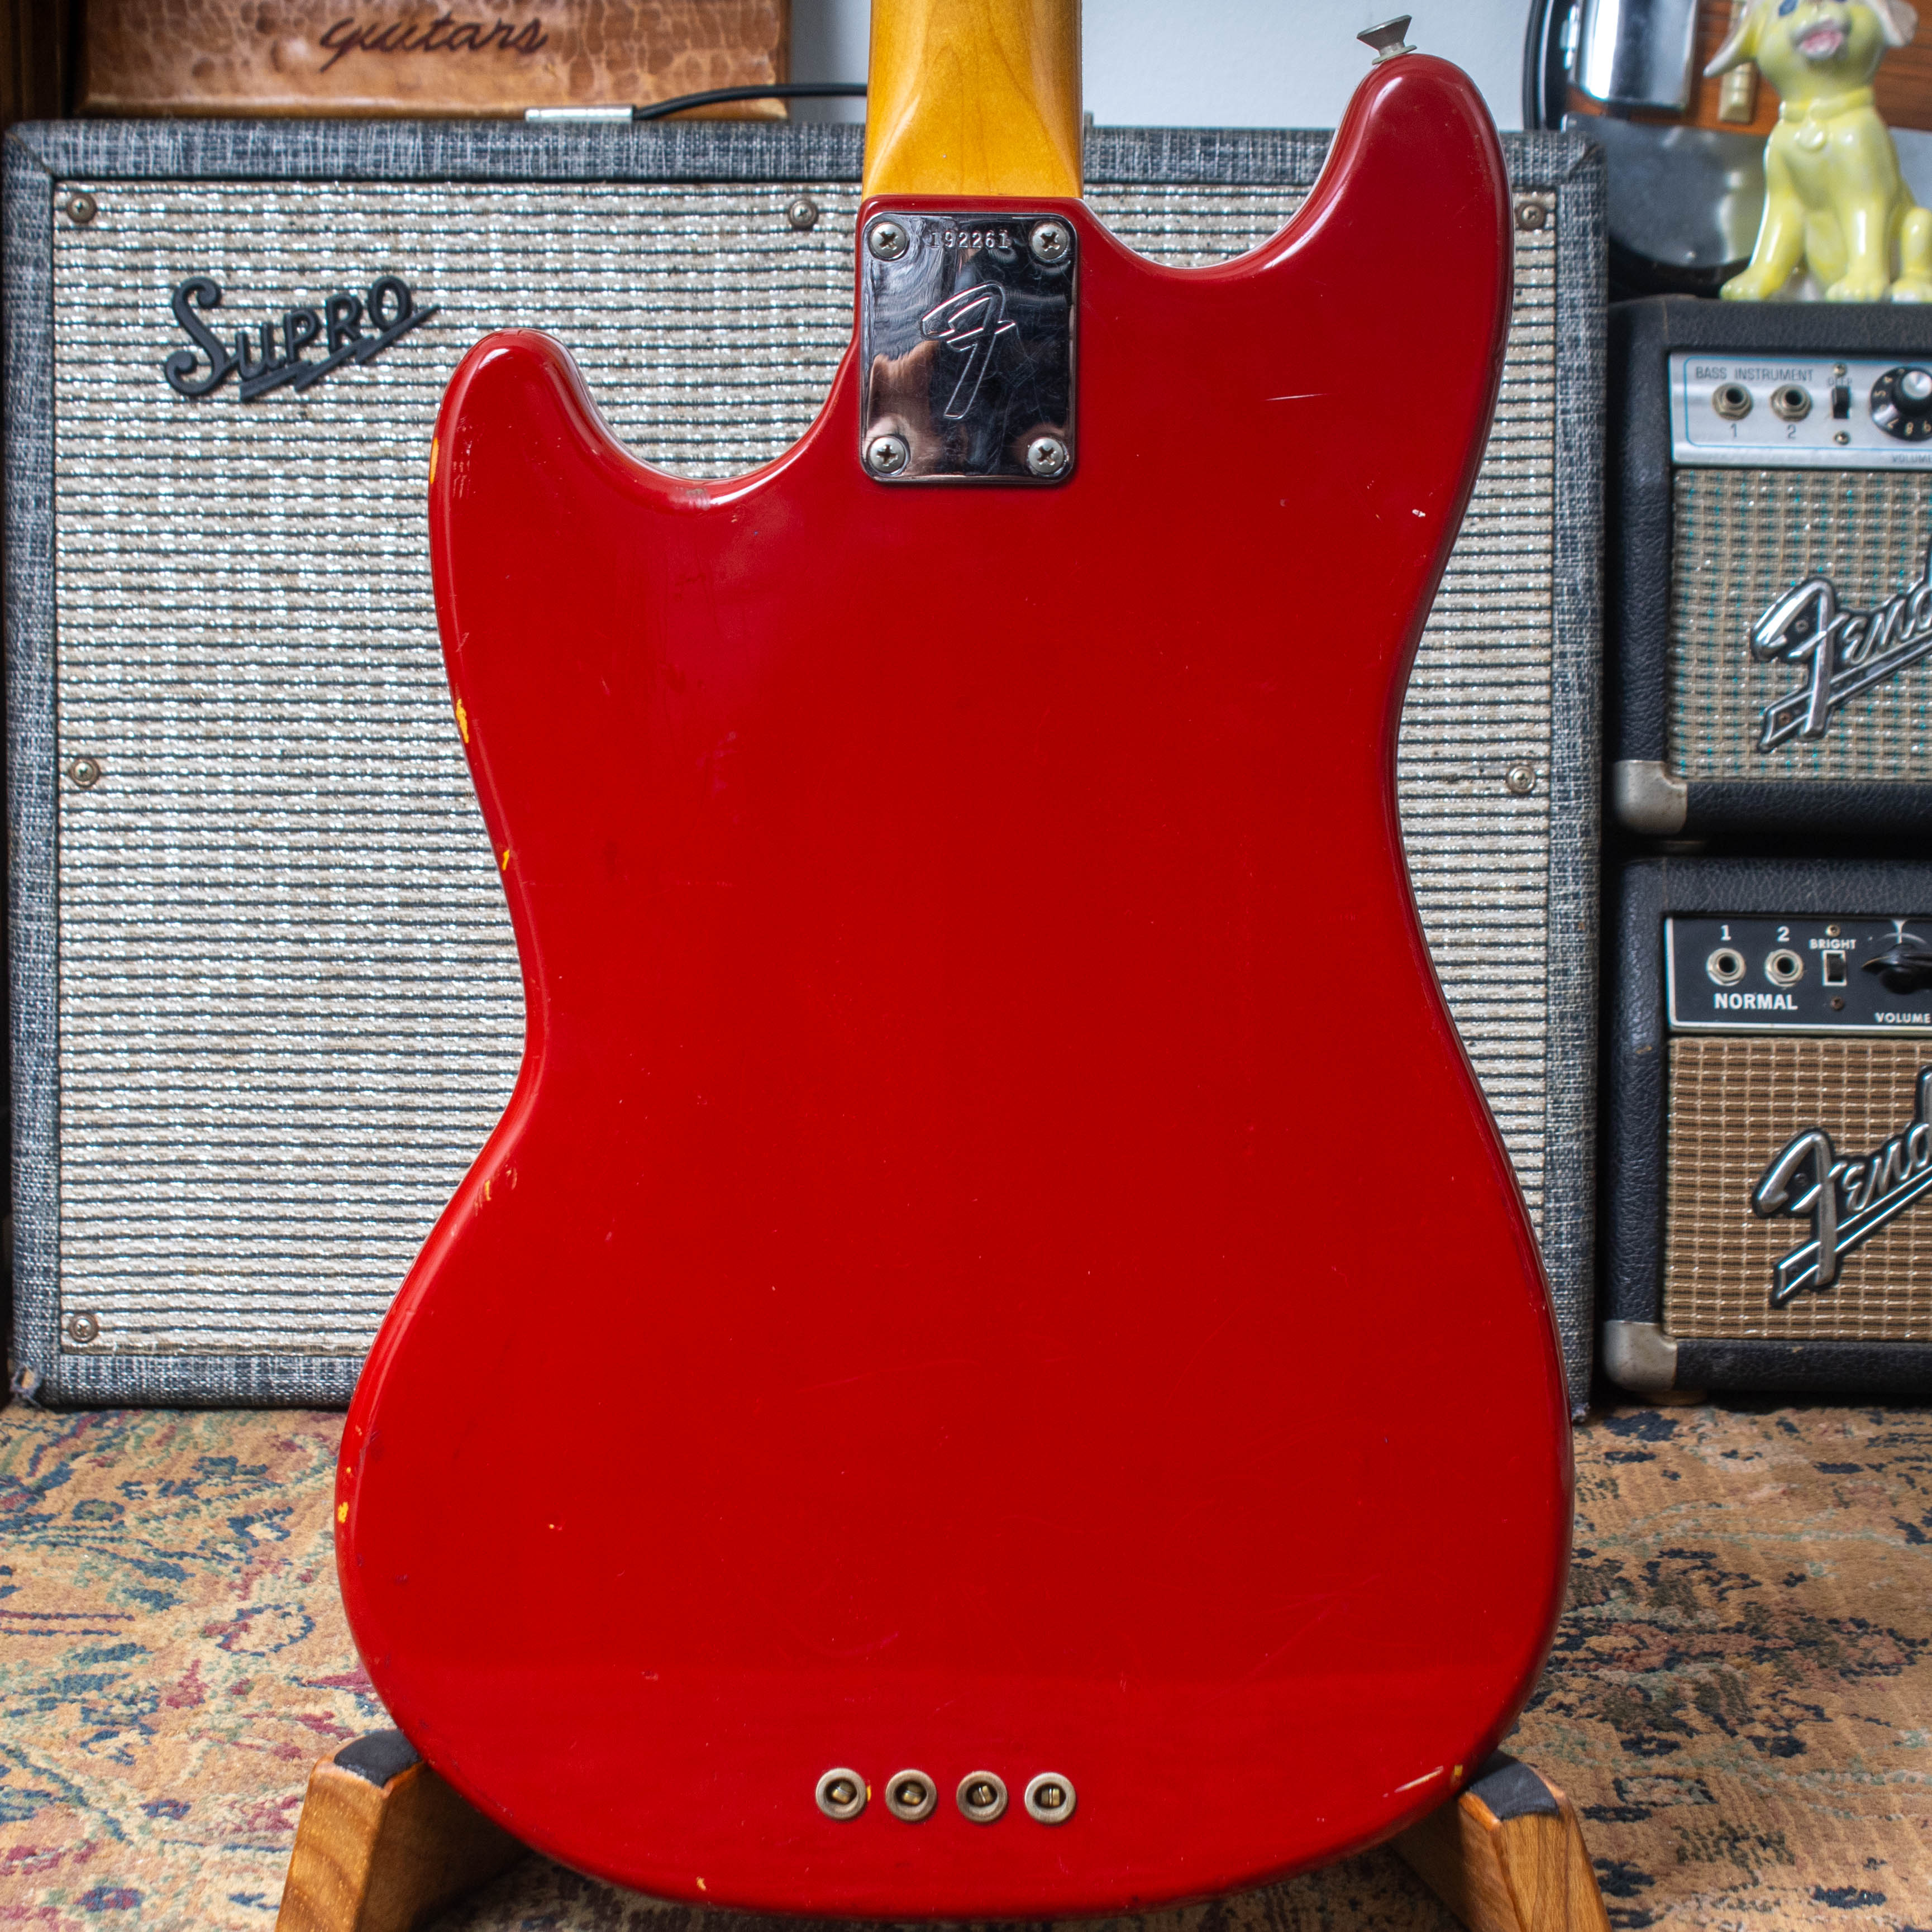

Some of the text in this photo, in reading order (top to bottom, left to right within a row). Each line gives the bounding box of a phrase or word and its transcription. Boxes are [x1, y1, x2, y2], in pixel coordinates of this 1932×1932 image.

[1695, 366, 1814, 381] BASS INSTRUMENT
[1730, 423, 1796, 440] 1 2
[1720, 924, 1790, 942] 1 2
[1809, 938, 1857, 950] BRIGHT
[1714, 993, 1799, 1011] NORMAL
[1874, 1012, 1931, 1024] VOLUME
